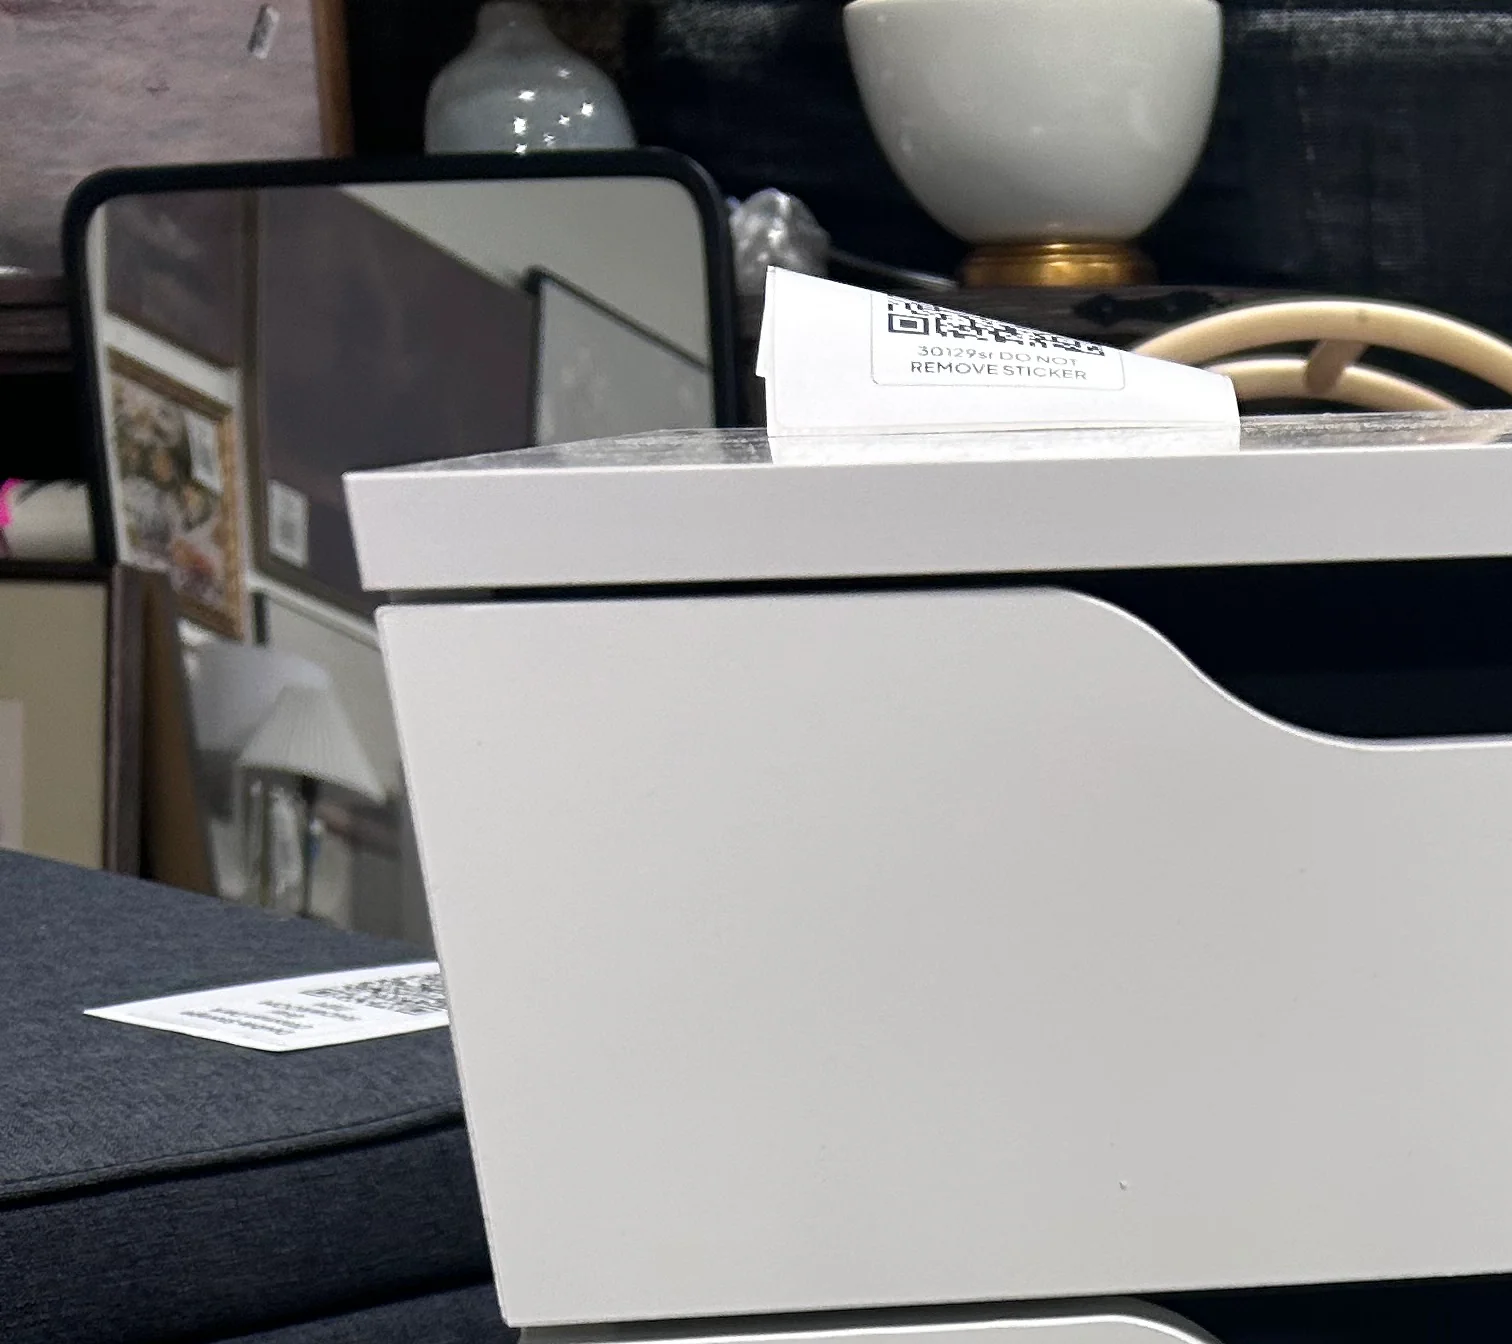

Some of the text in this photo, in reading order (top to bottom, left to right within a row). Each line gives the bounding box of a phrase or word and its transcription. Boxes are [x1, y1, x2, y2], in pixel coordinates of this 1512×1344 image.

[1000, 351, 1032, 362] DO
[1036, 355, 1078, 367] NOT
[911, 360, 1088, 380] REMOVE STICKER
